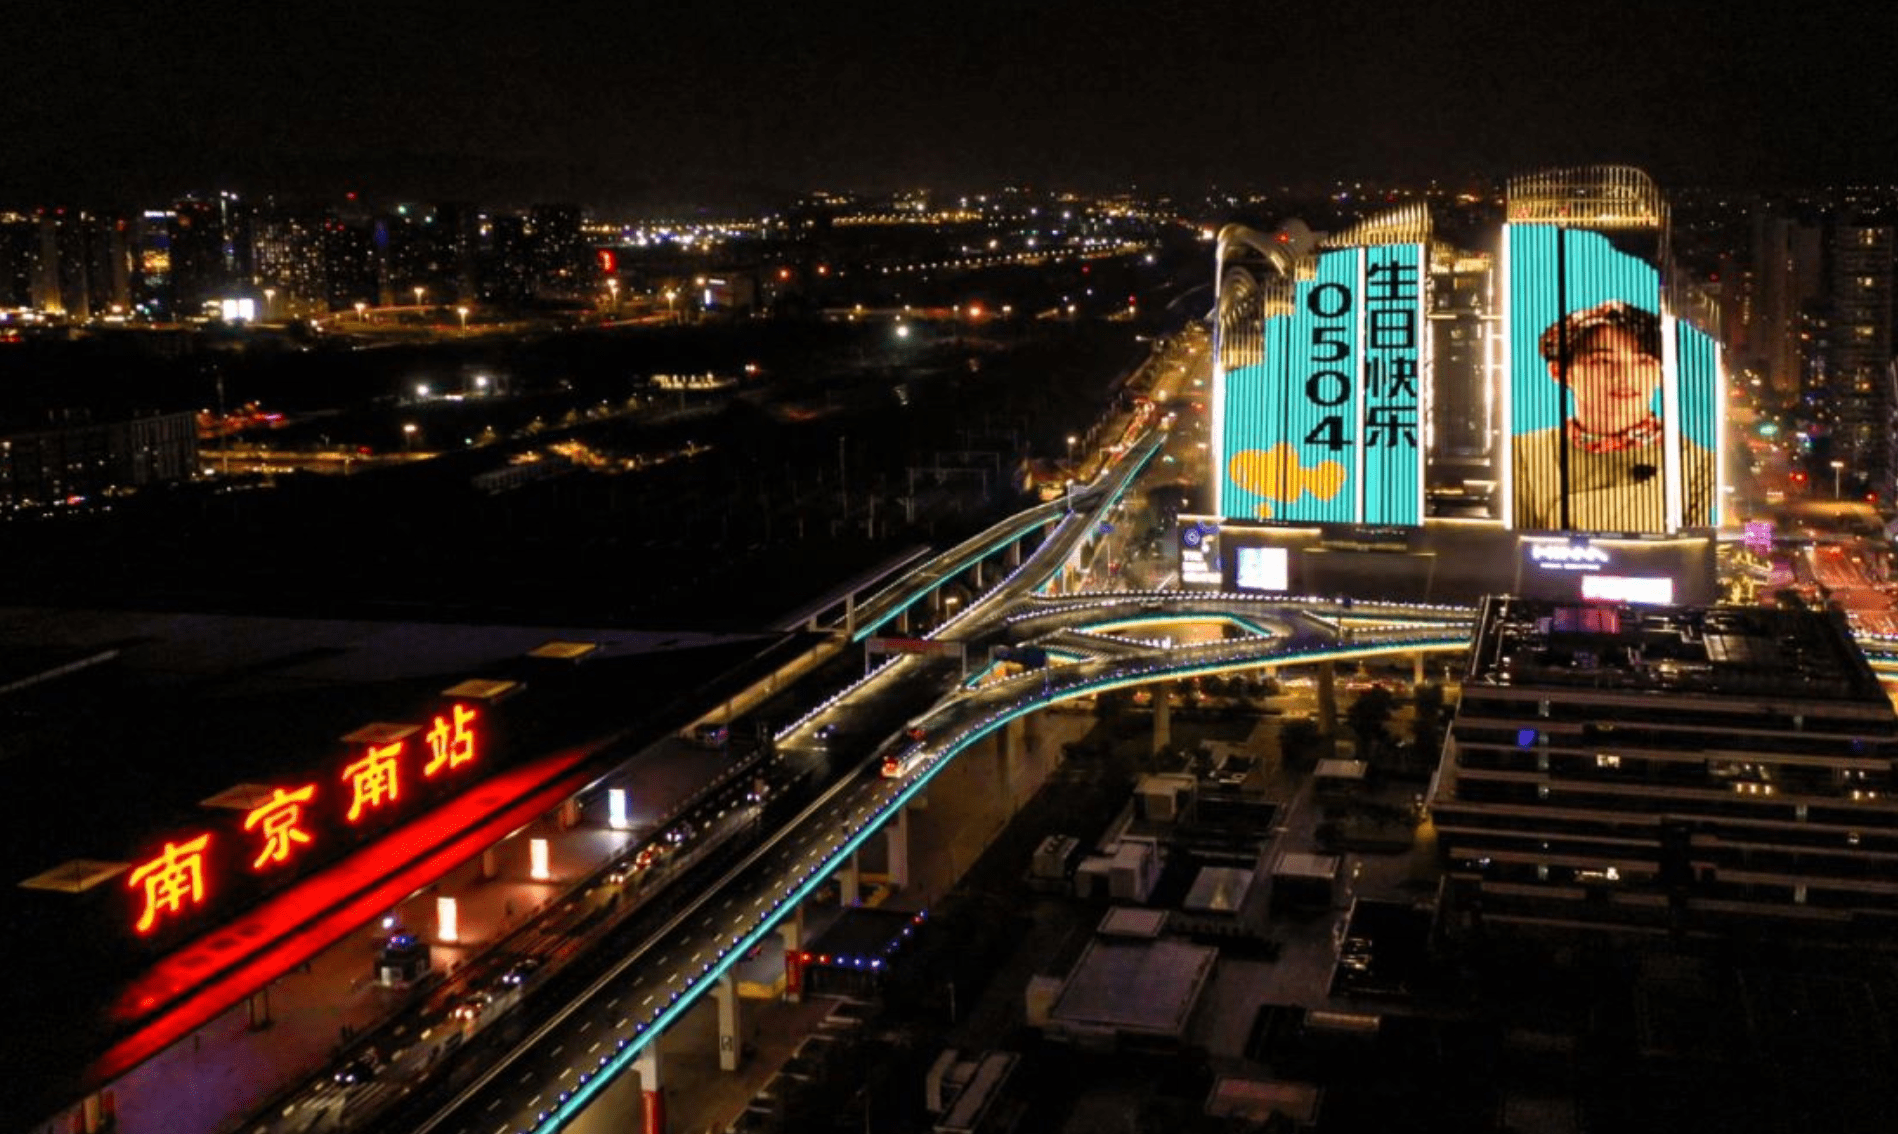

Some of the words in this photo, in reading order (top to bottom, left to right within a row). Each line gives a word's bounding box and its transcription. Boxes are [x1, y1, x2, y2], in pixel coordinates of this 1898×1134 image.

[1304, 283, 1353, 450] 0504
[1366, 261, 1417, 447] 生日快乐
[128, 704, 476, 931] 南京南站
